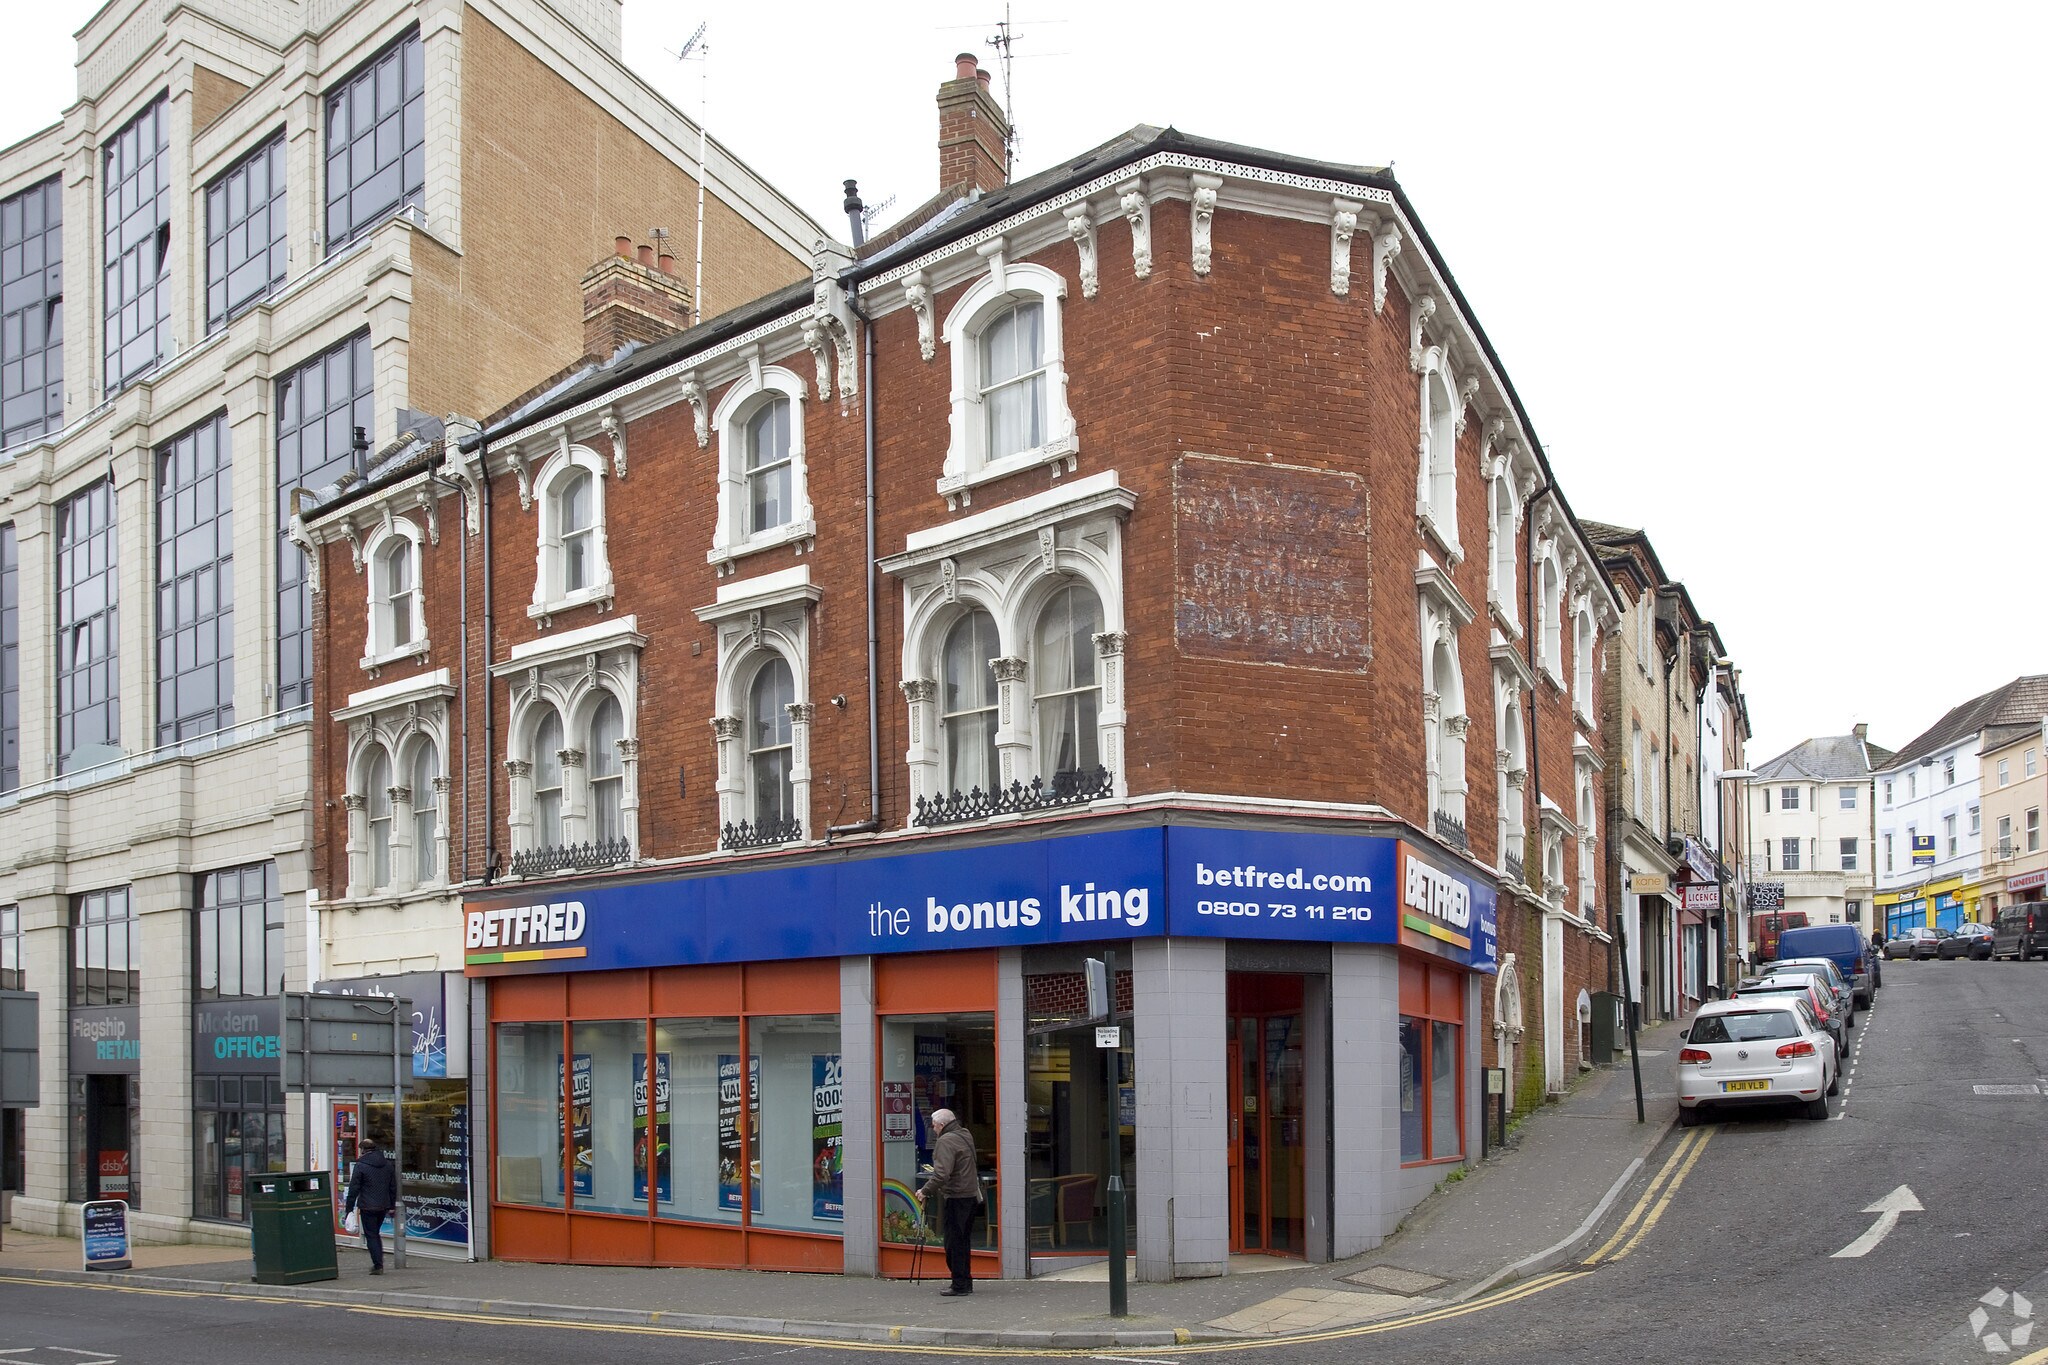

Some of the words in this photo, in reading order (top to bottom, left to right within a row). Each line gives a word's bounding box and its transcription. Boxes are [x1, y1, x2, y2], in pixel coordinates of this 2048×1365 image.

[1196, 863, 1372, 893] betfred.com
[1635, 877, 1661, 887] kane
[1405, 854, 1471, 930] BETFRED
[1688, 893, 1718, 902] LICENCE
[868, 901, 911, 937] the
[927, 896, 1041, 933] bonus
[1060, 882, 1149, 927] king
[1197, 900, 1260, 917] 0800
[1268, 903, 1297, 918] 73
[1305, 904, 1325, 919] 11
[1332, 905, 1372, 922] 210
[465, 901, 587, 949] BETFRED
[1480, 914, 1496, 937] bonus
[1485, 938, 1496, 962] king
[73, 1016, 126, 1042] Flagship
[198, 1010, 259, 1034] Modern
[720, 1059, 759, 1077] GREYHND
[636, 1081, 667, 1101] BOST
[723, 1079, 757, 1100] VALE
[893, 1084, 902, 1092] 30
[1731, 1082, 1746, 1091] HJ11
[1749, 1081, 1764, 1090] VLB
[816, 1089, 842, 1108] BOO
[448, 1120, 462, 1129] Print
[449, 1133, 462, 1143] Scan
[440, 1146, 462, 1156] Internet
[435, 1160, 462, 1170] Laminate
